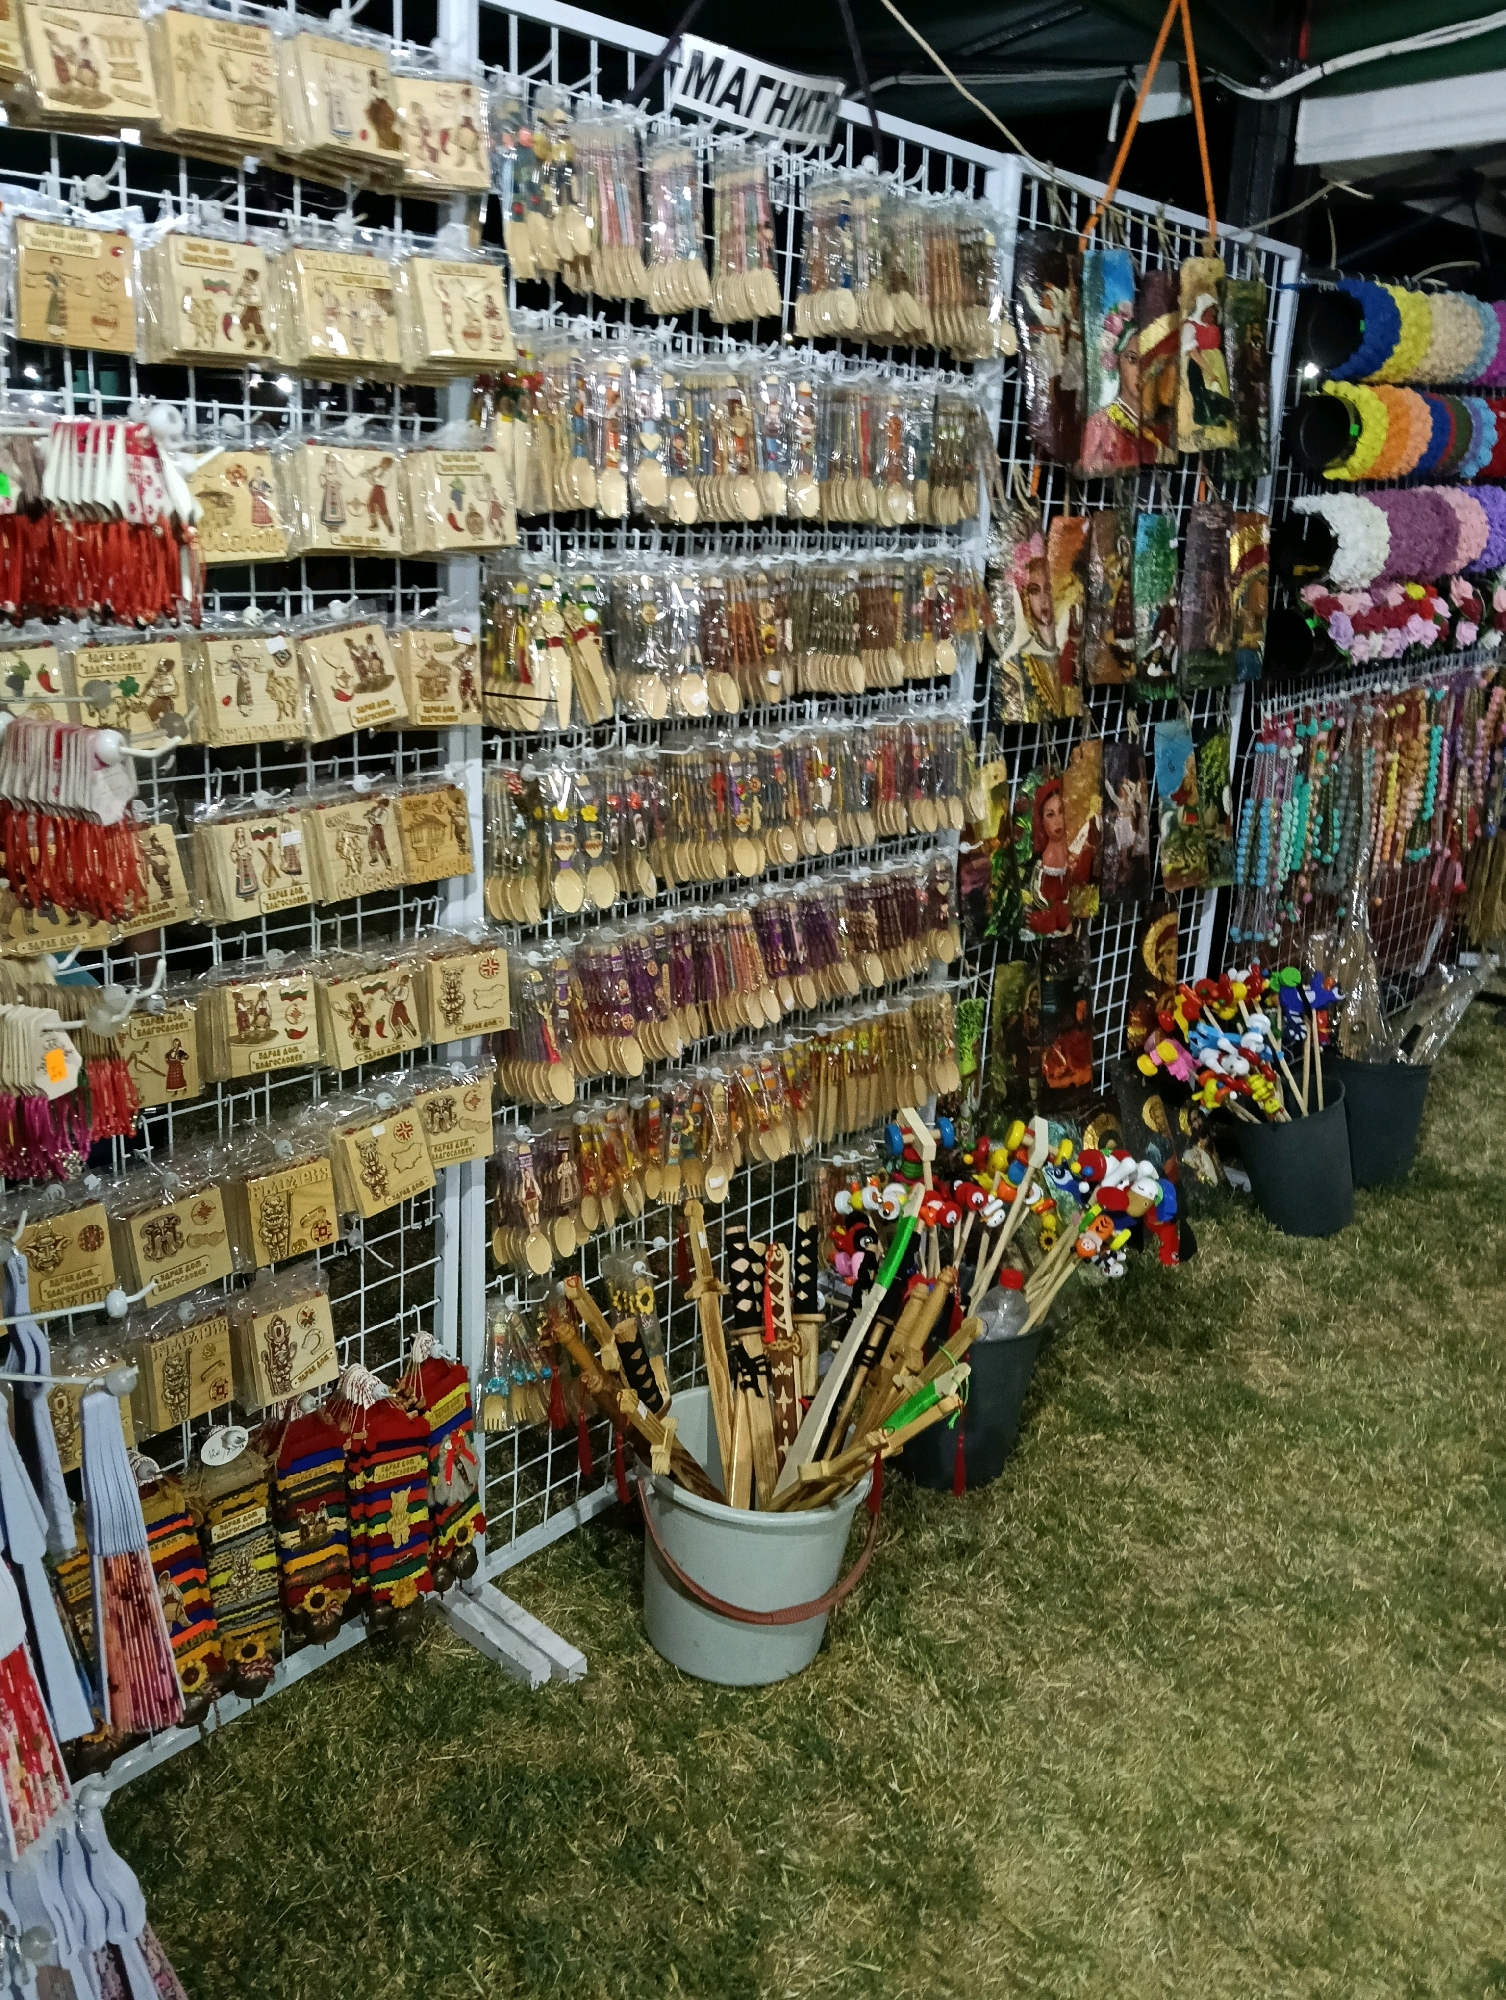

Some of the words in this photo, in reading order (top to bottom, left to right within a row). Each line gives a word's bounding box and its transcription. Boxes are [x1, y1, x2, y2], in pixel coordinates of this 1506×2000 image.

[137, 1021, 189, 1038] БЛАГОСЛОВЕН
[255, 1053, 303, 1070] БЛАГОСЛОВЕН
[258, 1049, 281, 1060] ЗДРАВ
[283, 1046, 299, 1056] ДОМ
[157, 1267, 208, 1293] БЛАГОСЛОВЕН
[216, 1516, 263, 1541] БЛАГОСЛОВЕН
[219, 1518, 241, 1532] ЗДРАВ
[242, 1510, 258, 1523] ДОМ
